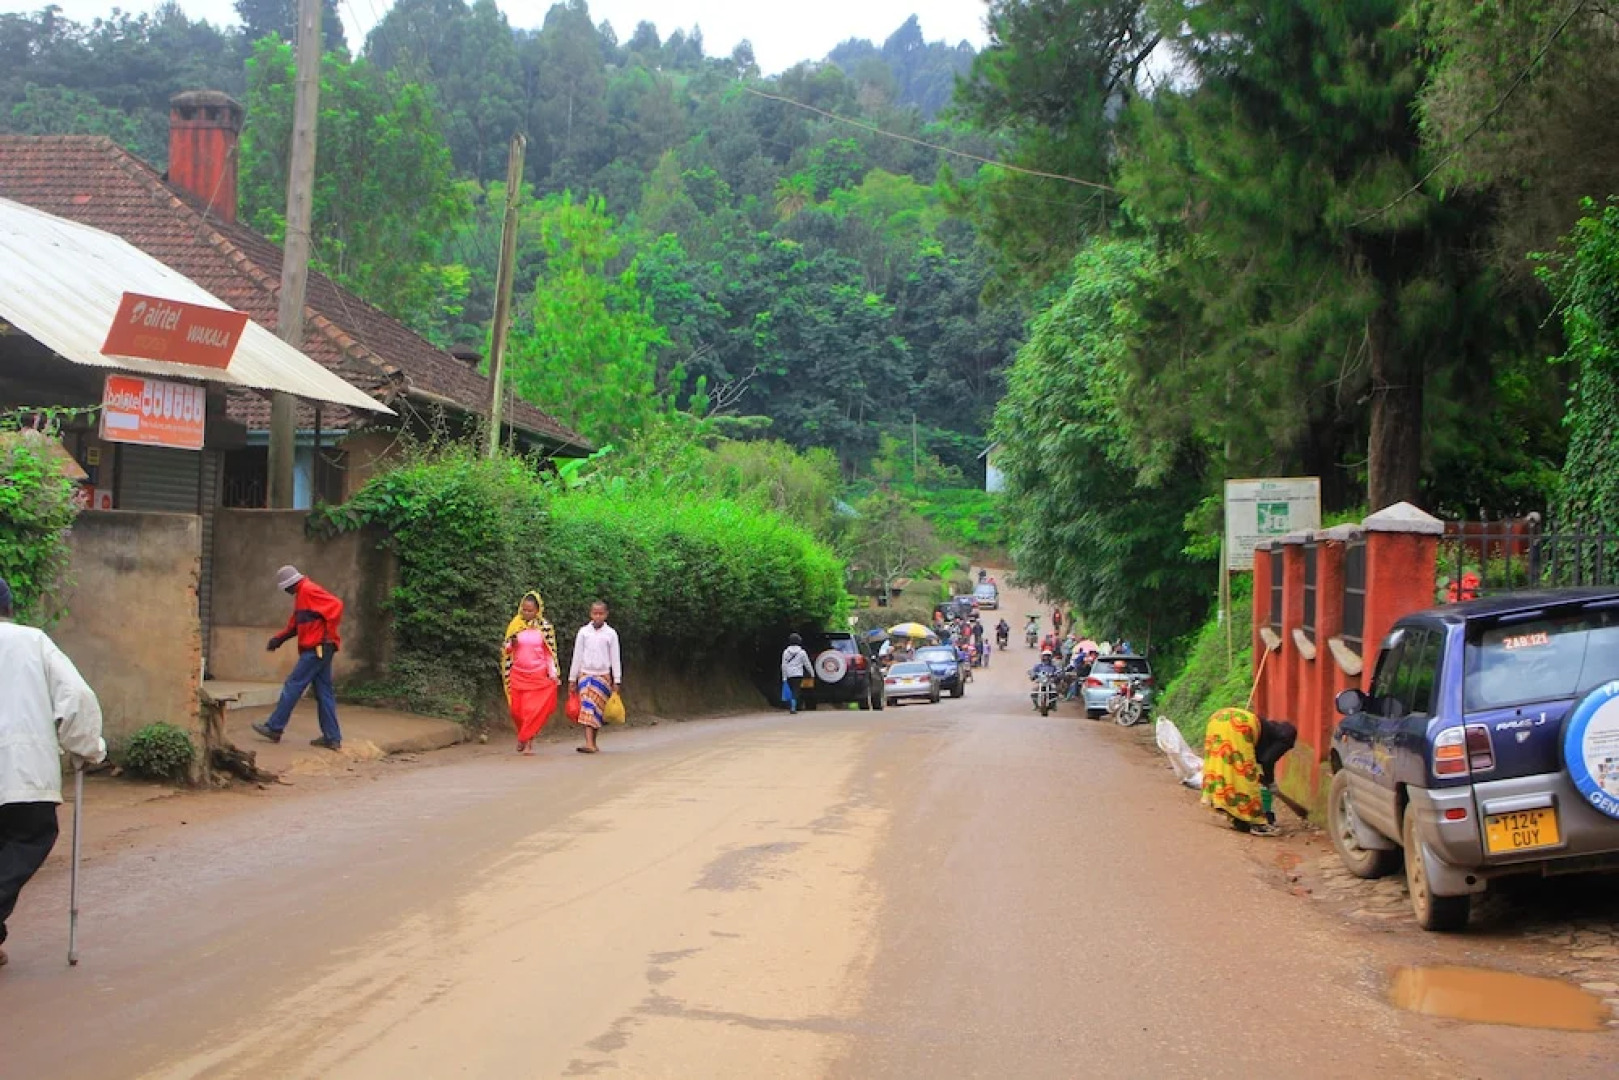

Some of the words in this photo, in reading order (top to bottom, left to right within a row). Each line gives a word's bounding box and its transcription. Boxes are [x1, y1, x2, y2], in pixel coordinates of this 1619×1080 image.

[143, 302, 184, 331] airtel
[186, 323, 231, 349] WAKALA
[1590, 791, 1619, 816] GEN
[1501, 812, 1539, 832] T124
[1513, 829, 1540, 847] CUY
